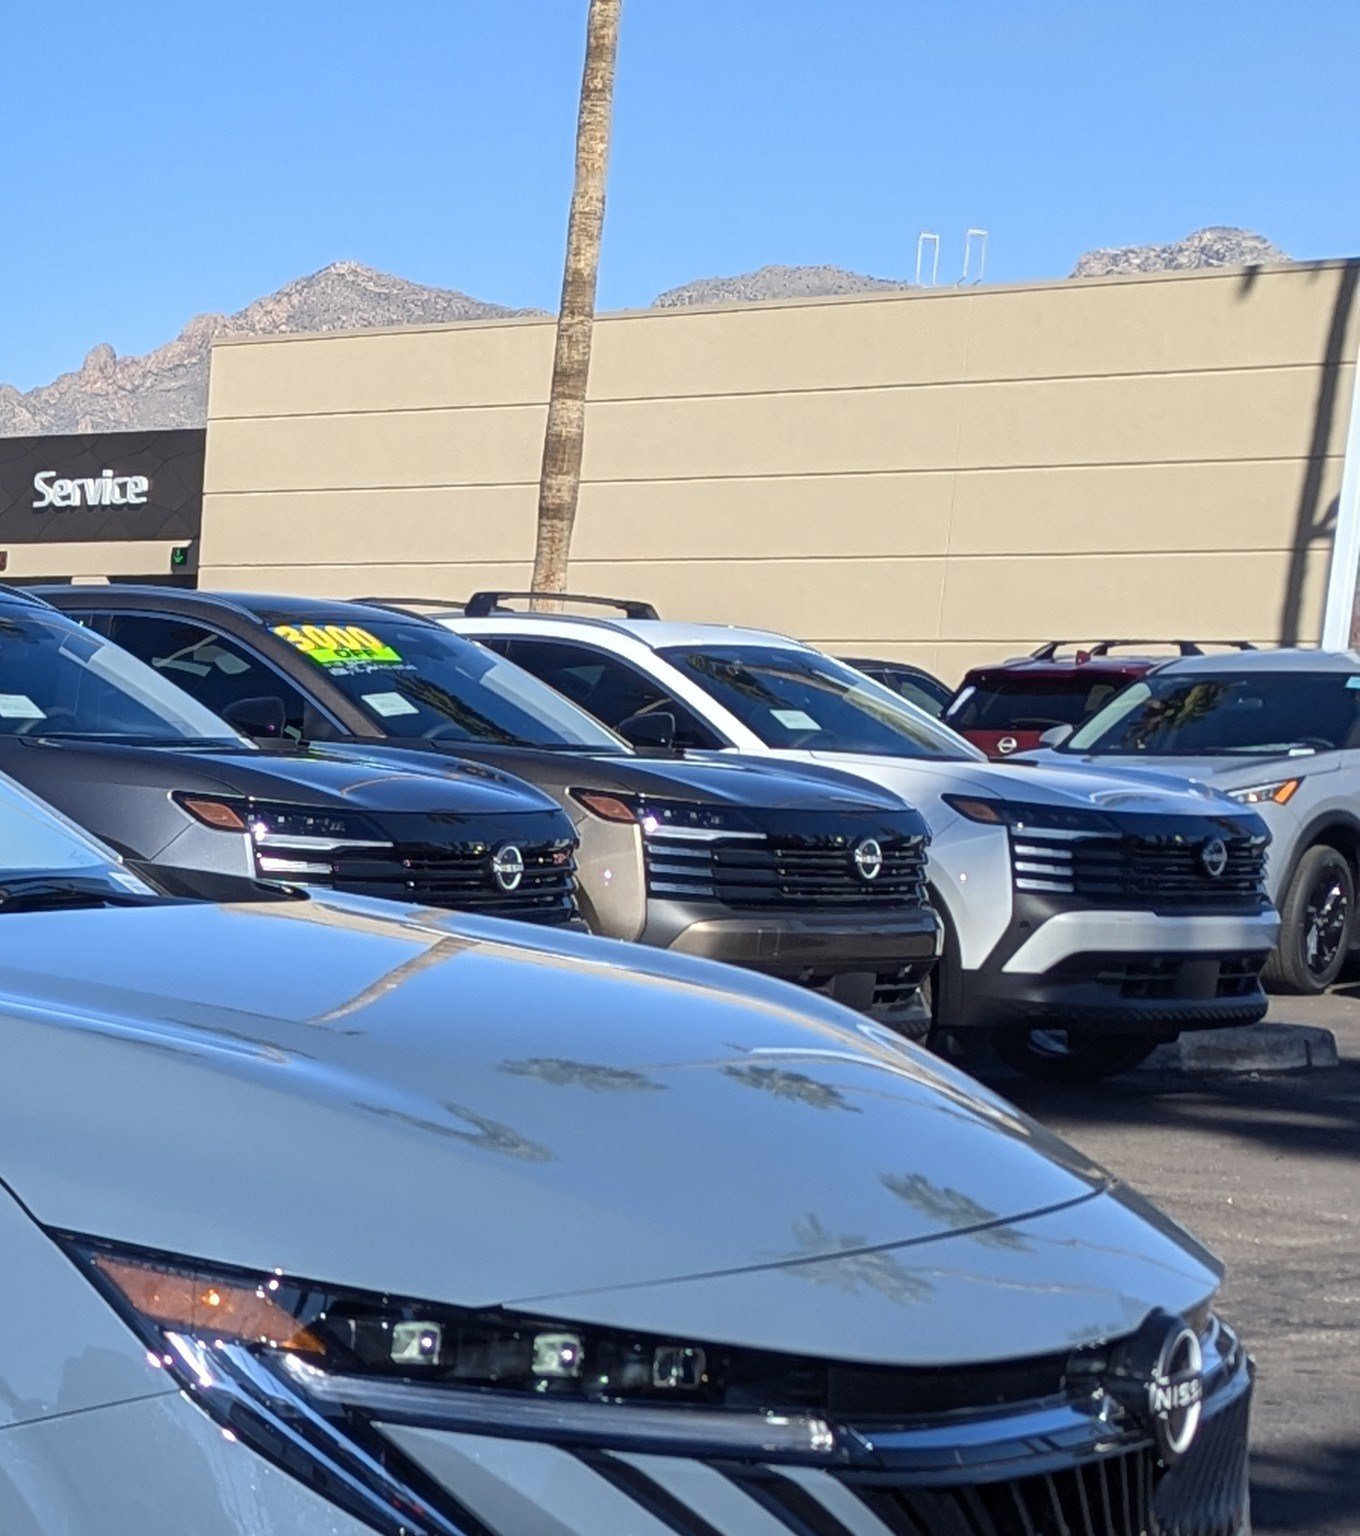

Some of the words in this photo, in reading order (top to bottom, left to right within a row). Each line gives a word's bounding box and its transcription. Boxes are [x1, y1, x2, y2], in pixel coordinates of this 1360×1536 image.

[32, 468, 149, 508] Service
[272, 625, 385, 652] 3000
[333, 649, 378, 659] OFF
